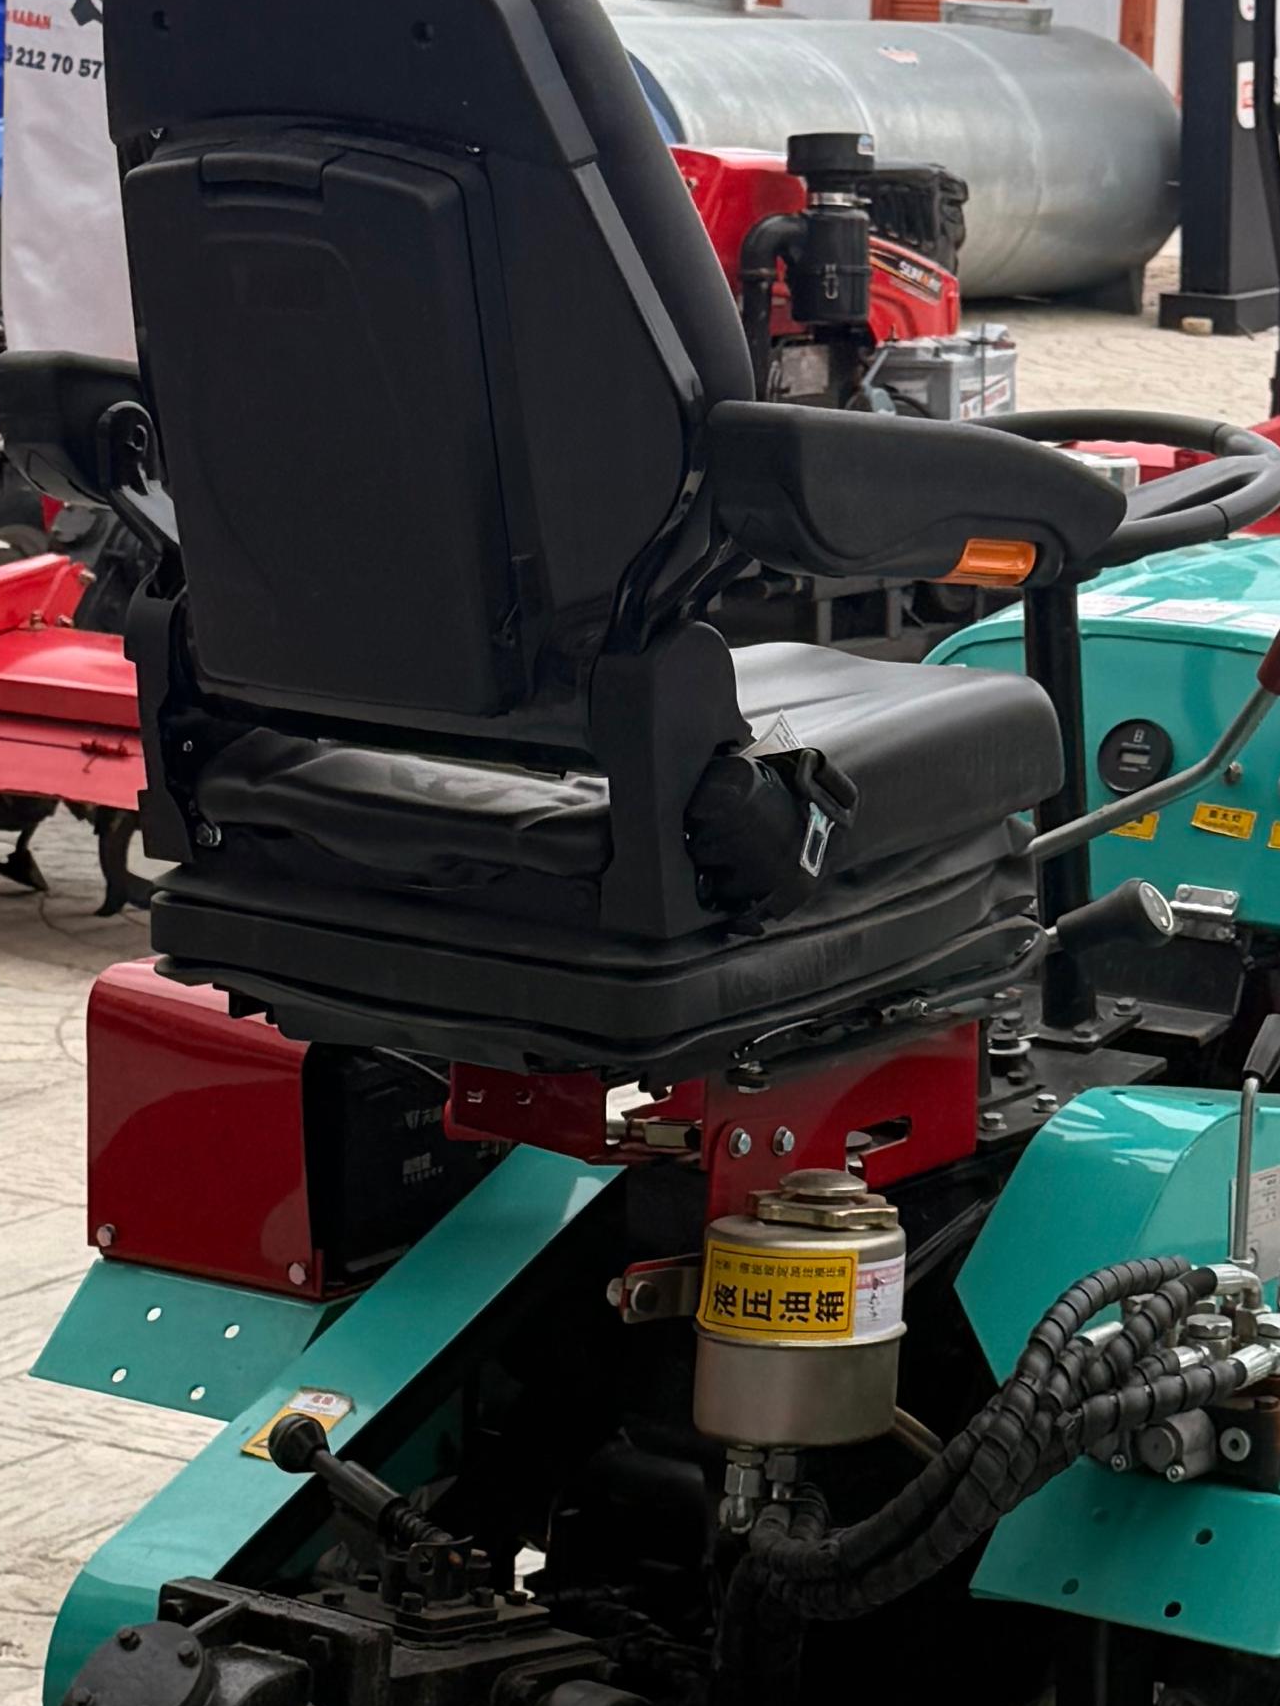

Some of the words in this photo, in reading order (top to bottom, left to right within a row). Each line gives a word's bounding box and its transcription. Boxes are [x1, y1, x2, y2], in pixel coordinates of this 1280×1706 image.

[15, 46, 46, 70] 212
[51, 52, 74, 76] 70
[78, 58, 104, 80] 57
[713, 1280, 846, 1324] 液压油箱
